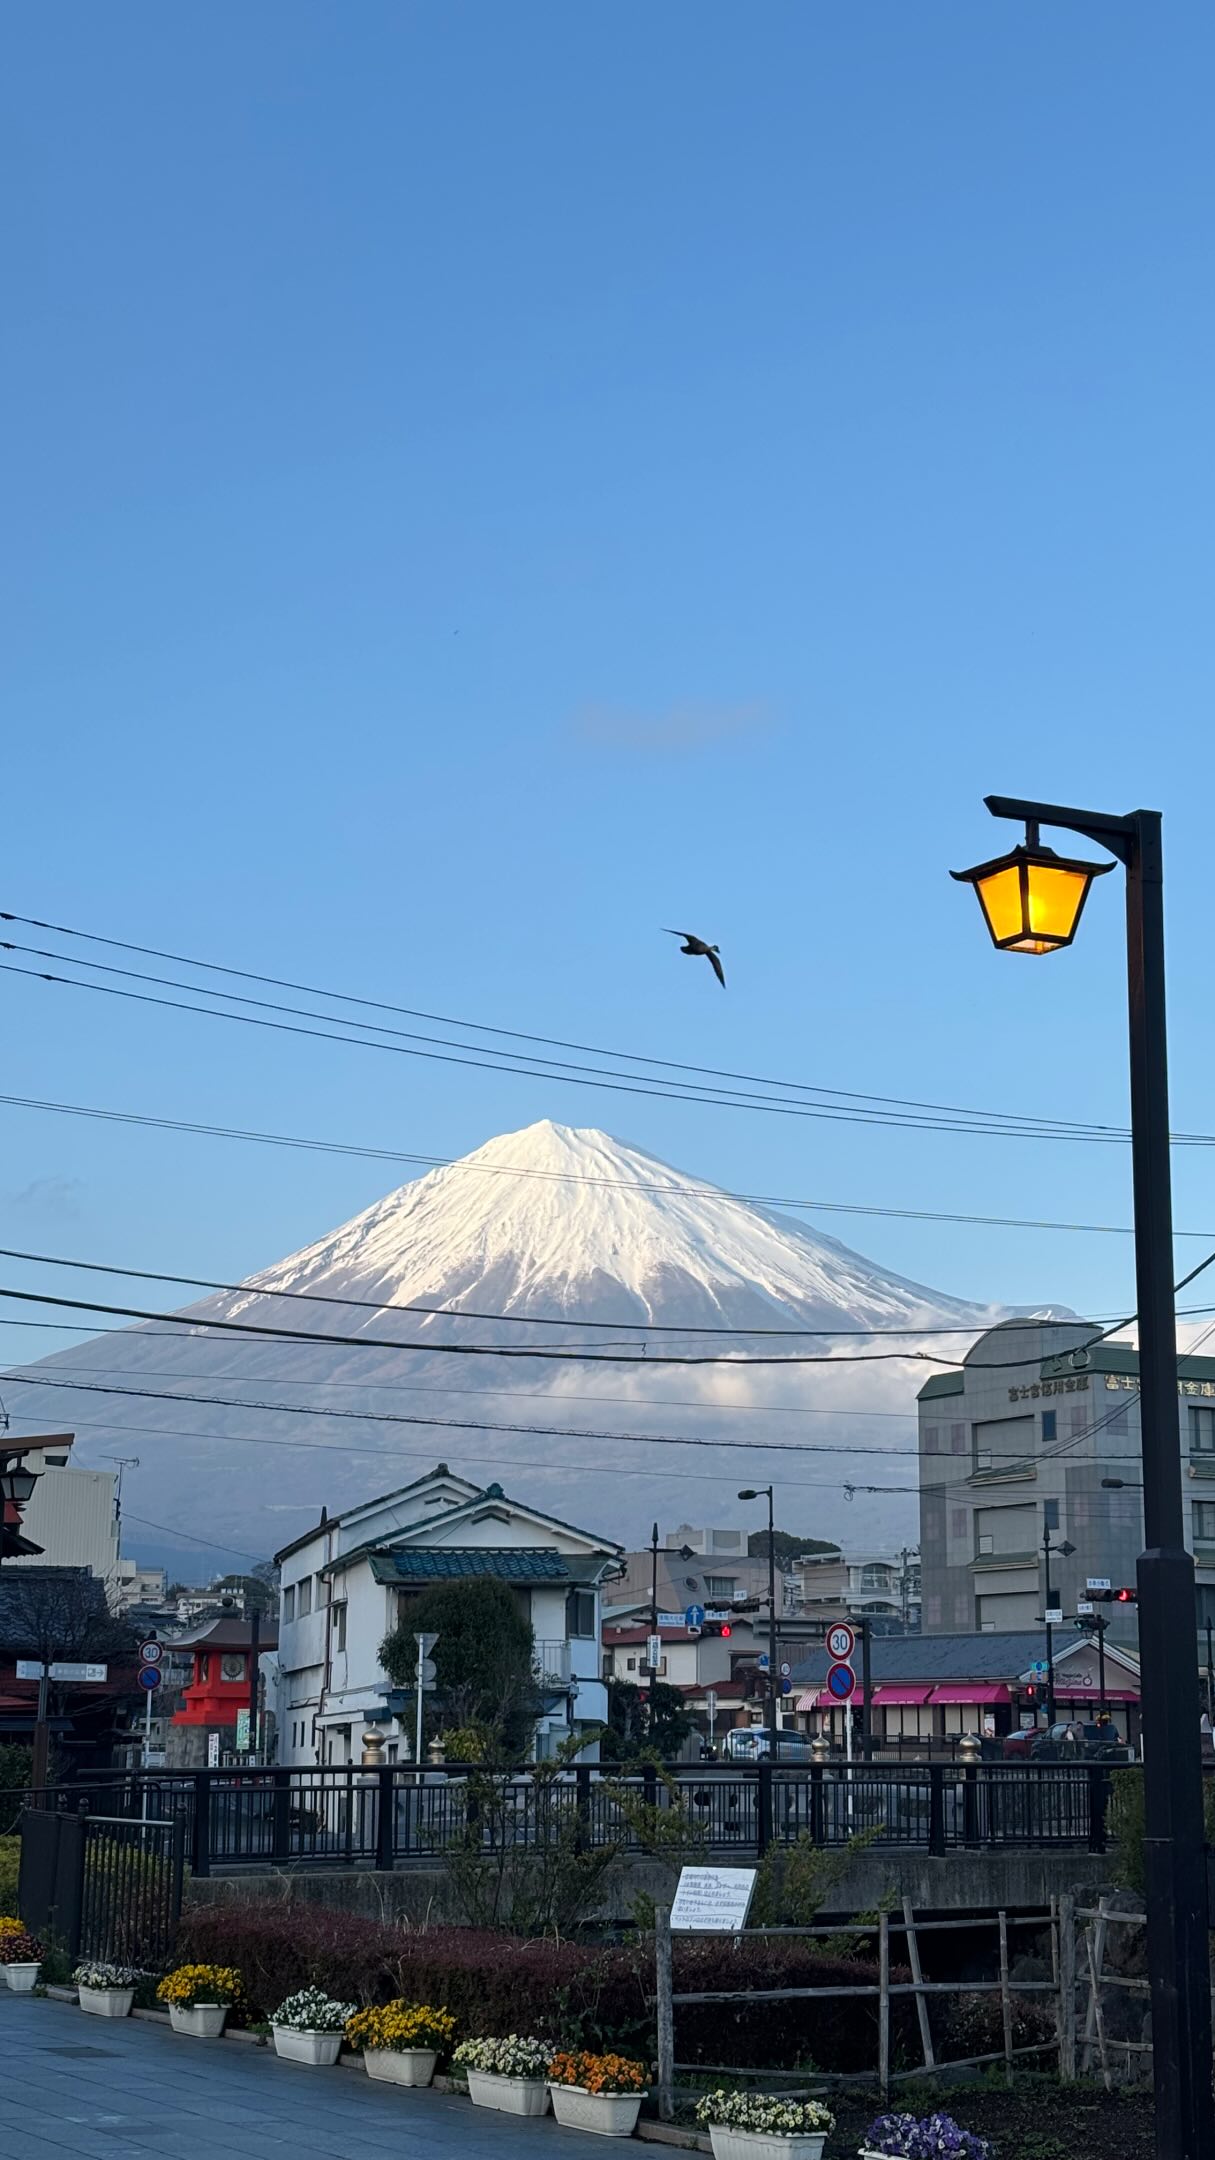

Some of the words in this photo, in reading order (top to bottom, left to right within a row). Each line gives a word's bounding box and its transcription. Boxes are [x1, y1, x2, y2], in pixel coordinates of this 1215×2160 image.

[1008, 1376, 1089, 1402] 富士宮信用金庫
[832, 1634, 848, 1650] 30
[145, 1647, 158, 1658] 30
